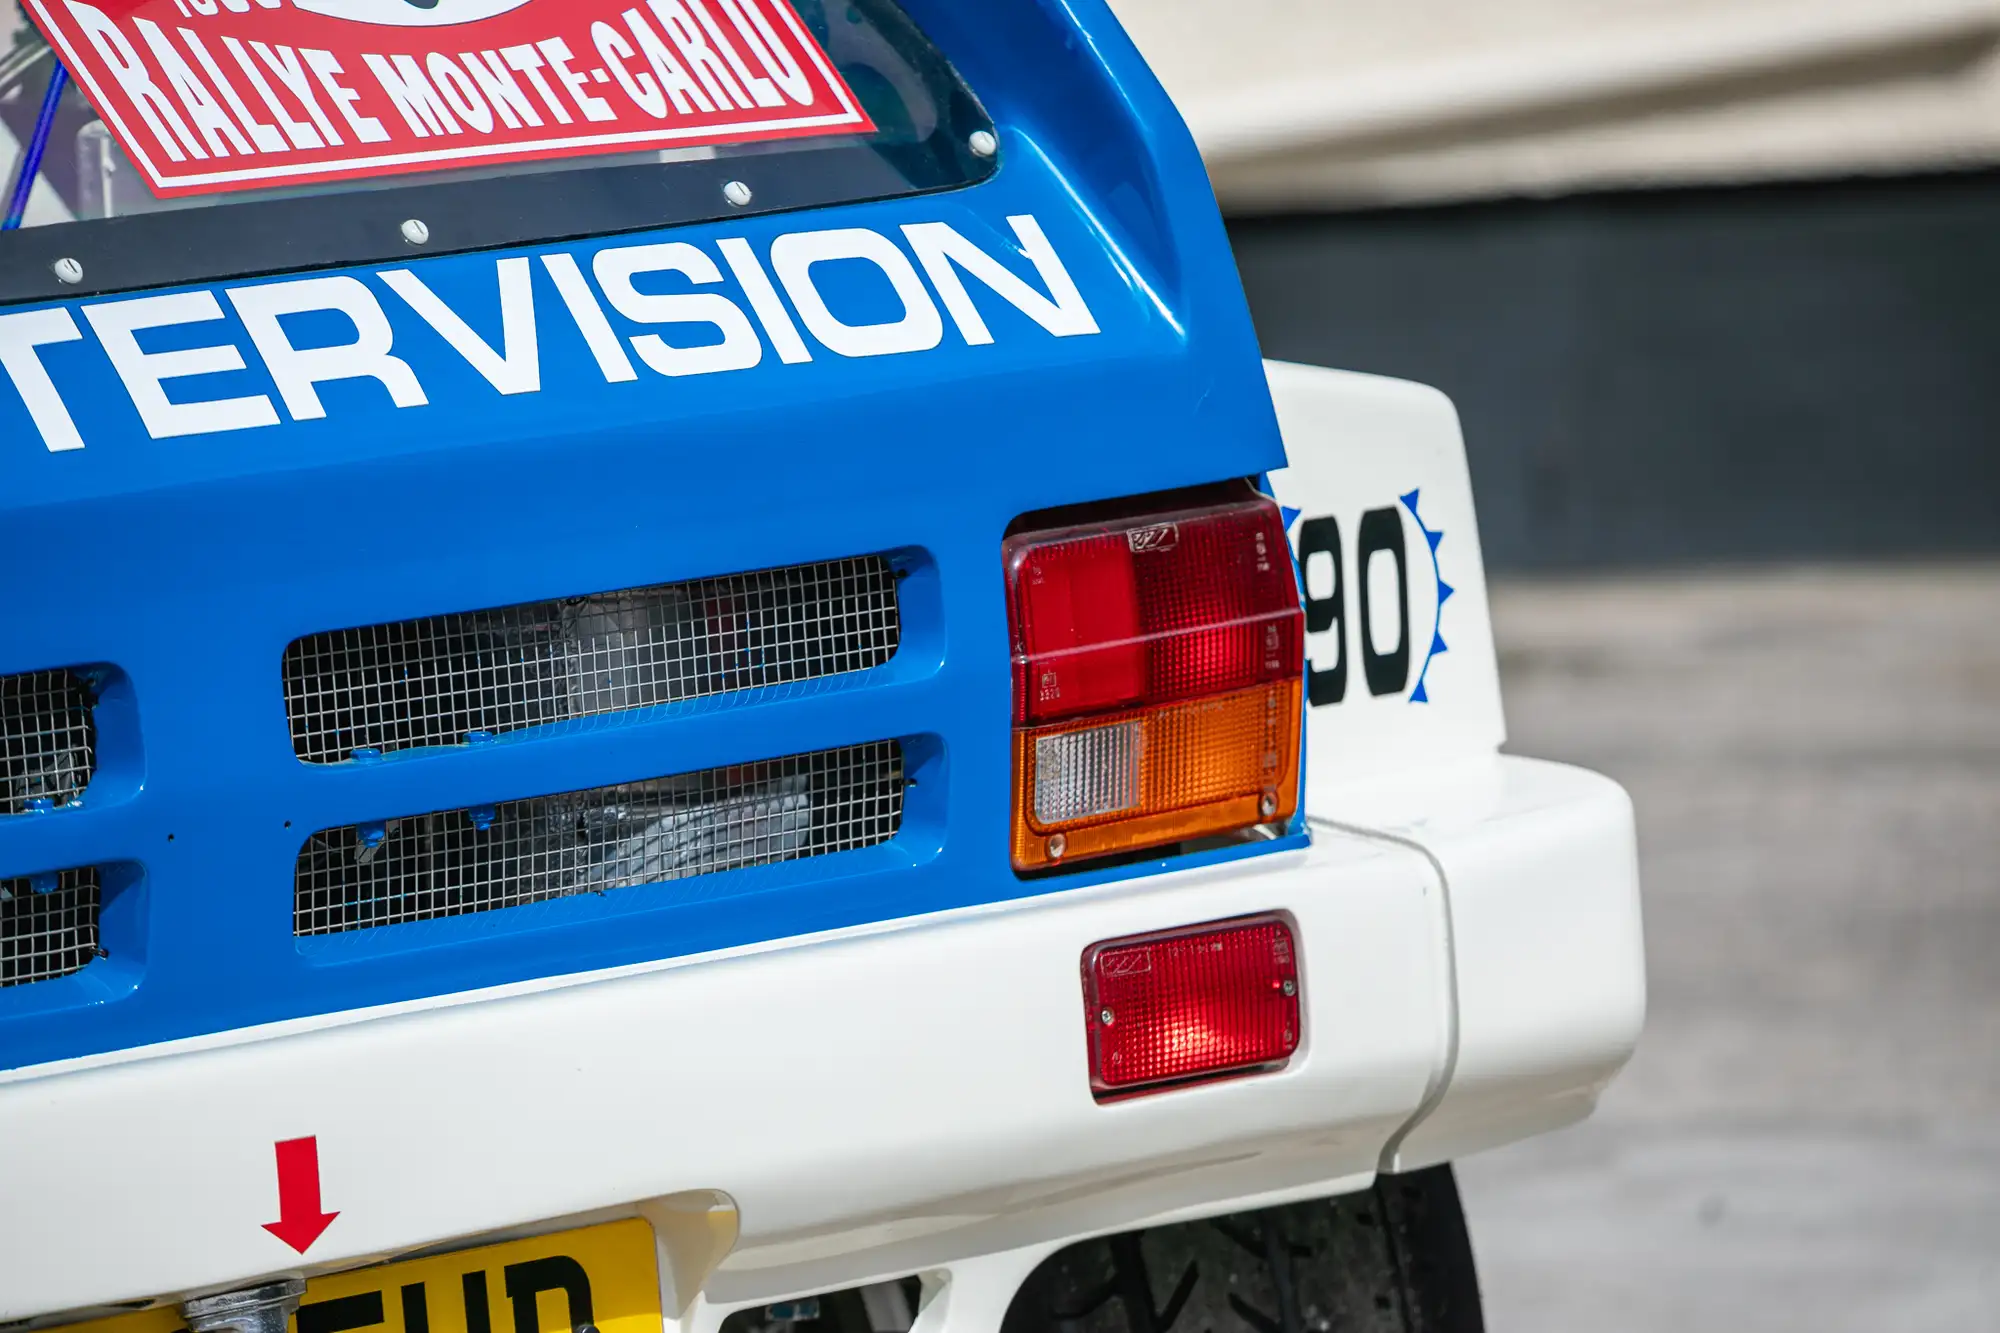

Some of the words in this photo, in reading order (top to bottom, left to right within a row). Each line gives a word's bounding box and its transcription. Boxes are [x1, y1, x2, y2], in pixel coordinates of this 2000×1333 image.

[61, 0, 391, 163] RALLYE
[0, 213, 1101, 453] TERVISION
[1298, 505, 1410, 708] 90
